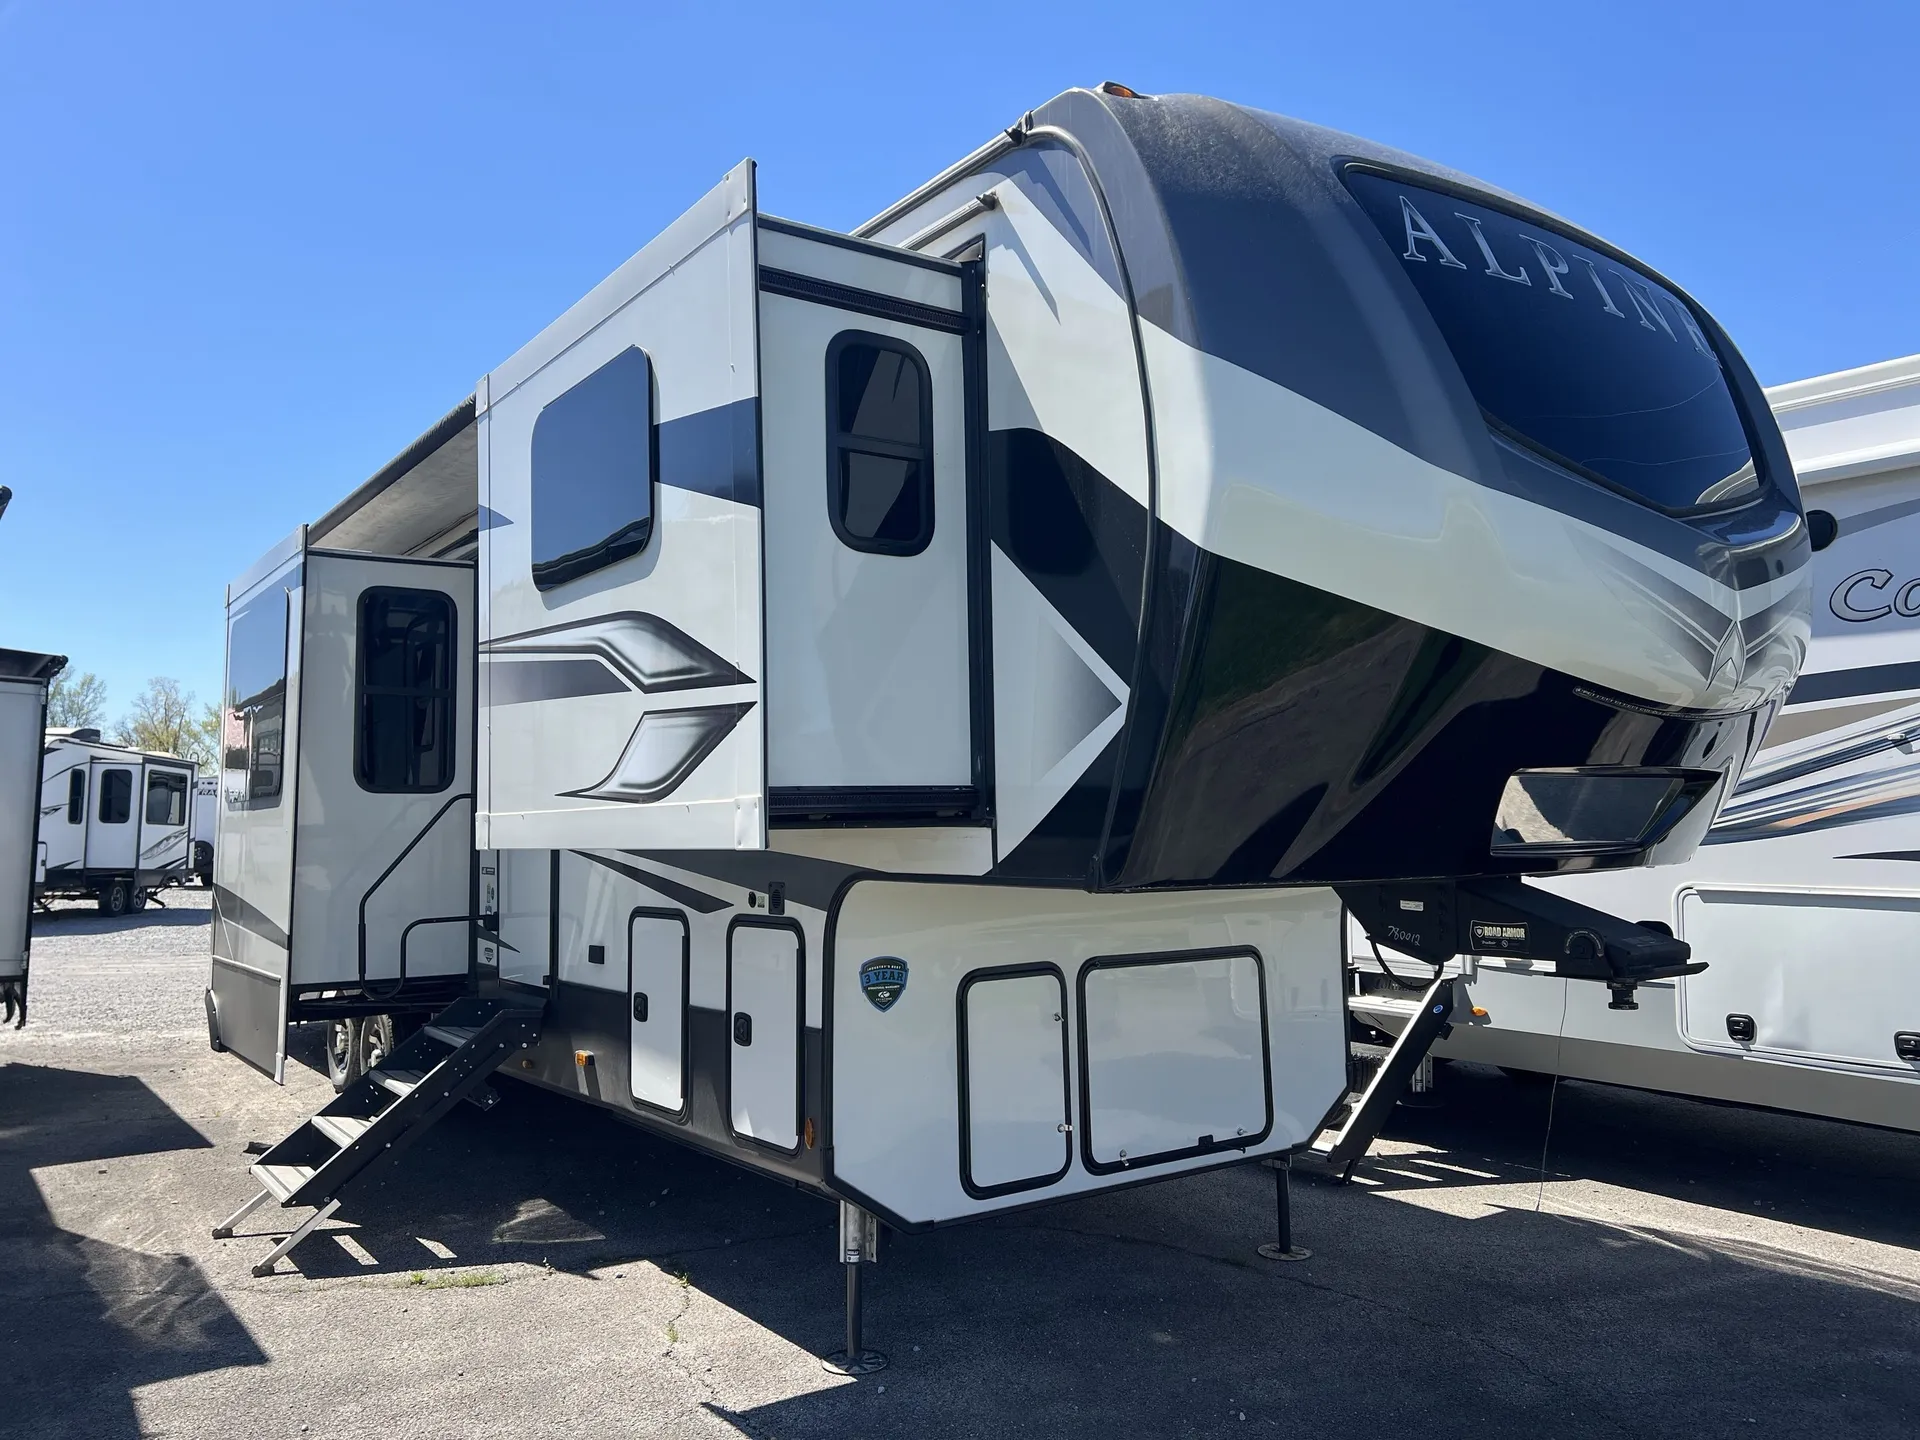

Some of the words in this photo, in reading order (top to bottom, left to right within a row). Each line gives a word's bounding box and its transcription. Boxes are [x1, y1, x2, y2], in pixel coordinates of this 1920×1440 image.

[1399, 195, 1723, 369] ALPINE
[1484, 926, 1501, 937] ROAD
[1502, 927, 1526, 939] ARMOR
[864, 974, 871, 984] 3
[874, 970, 904, 982] YEAR
